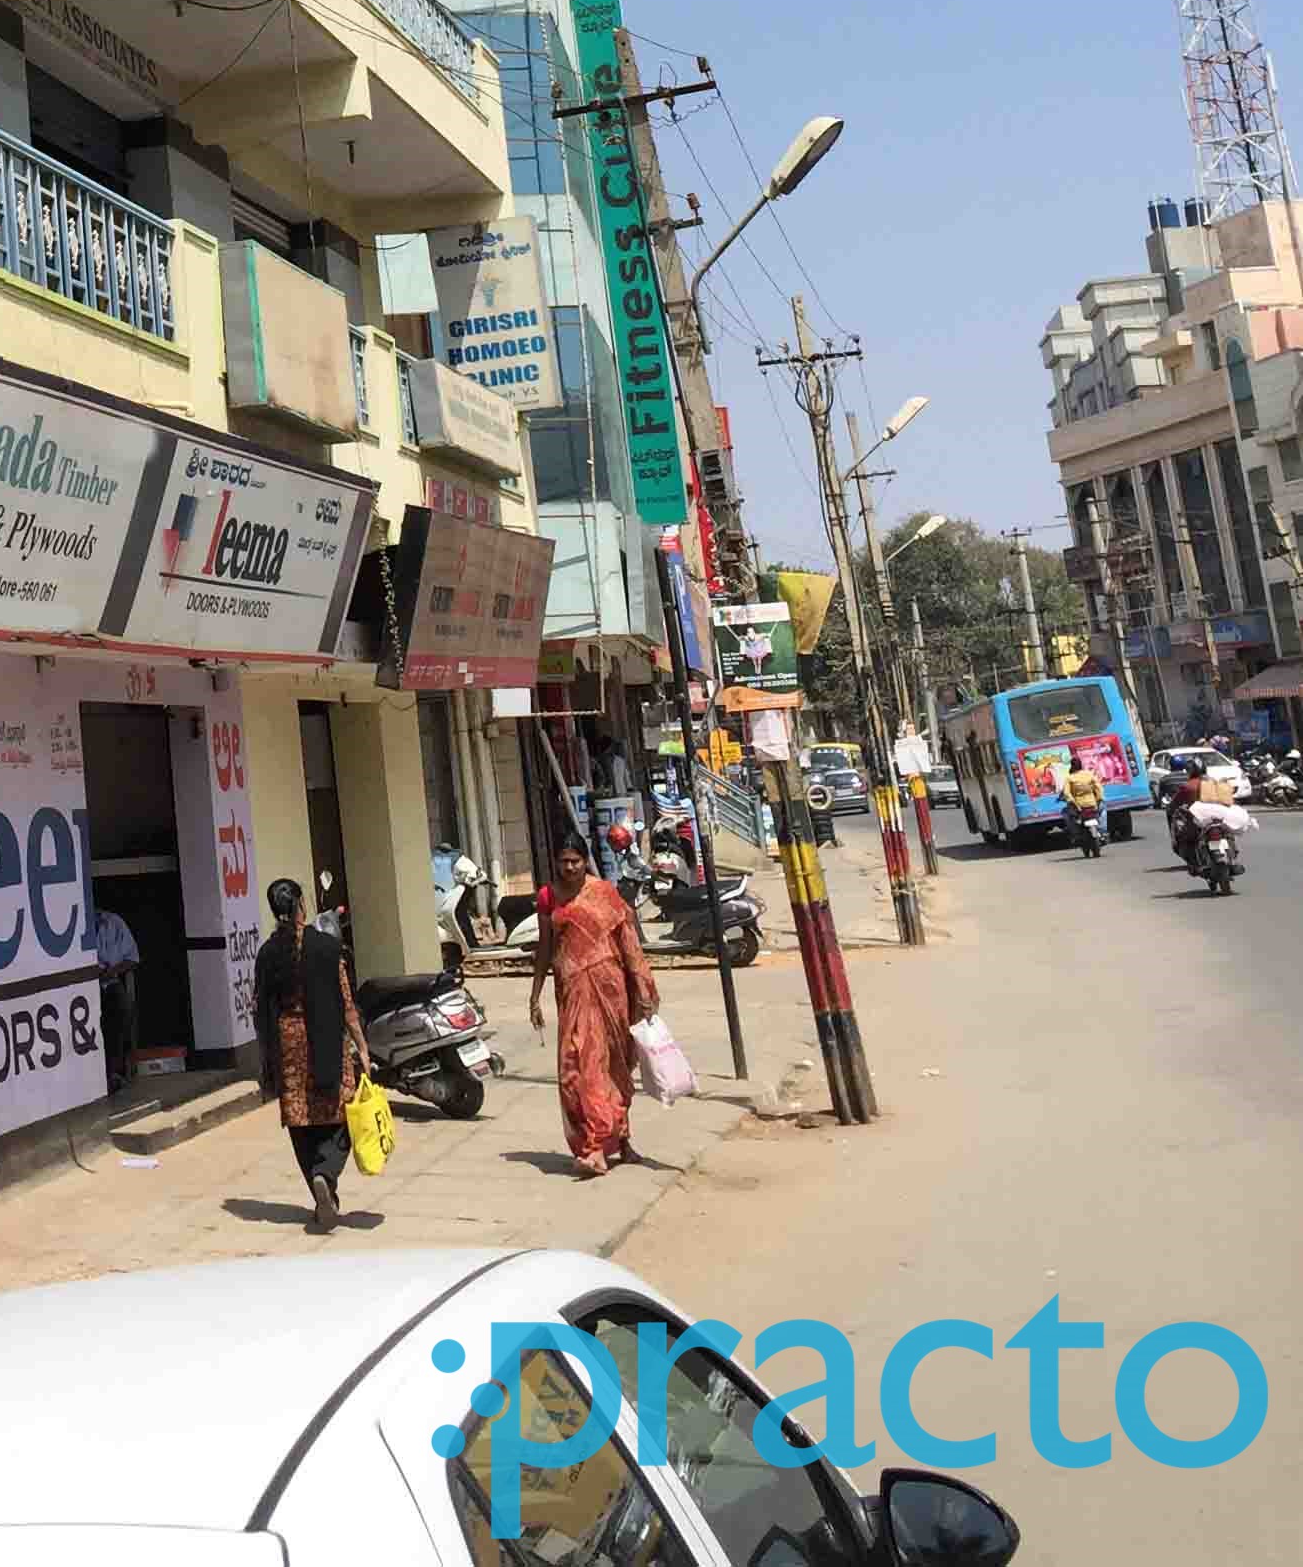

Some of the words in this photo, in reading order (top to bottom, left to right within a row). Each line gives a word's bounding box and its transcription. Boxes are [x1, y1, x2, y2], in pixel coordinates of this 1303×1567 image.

[62, 0, 159, 86] ASSOCIATES
[449, 309, 537, 338] GIRISRI
[615, 223, 671, 437] Fitness
[447, 335, 547, 366] HOMOEO
[56, 455, 119, 505] Timber
[4, 511, 97, 561] Plywoods
[202, 490, 289, 585] leema
[186, 593, 221, 614] DOORS
[229, 599, 271, 618] PLYWOODS
[68, 995, 99, 1056] &
